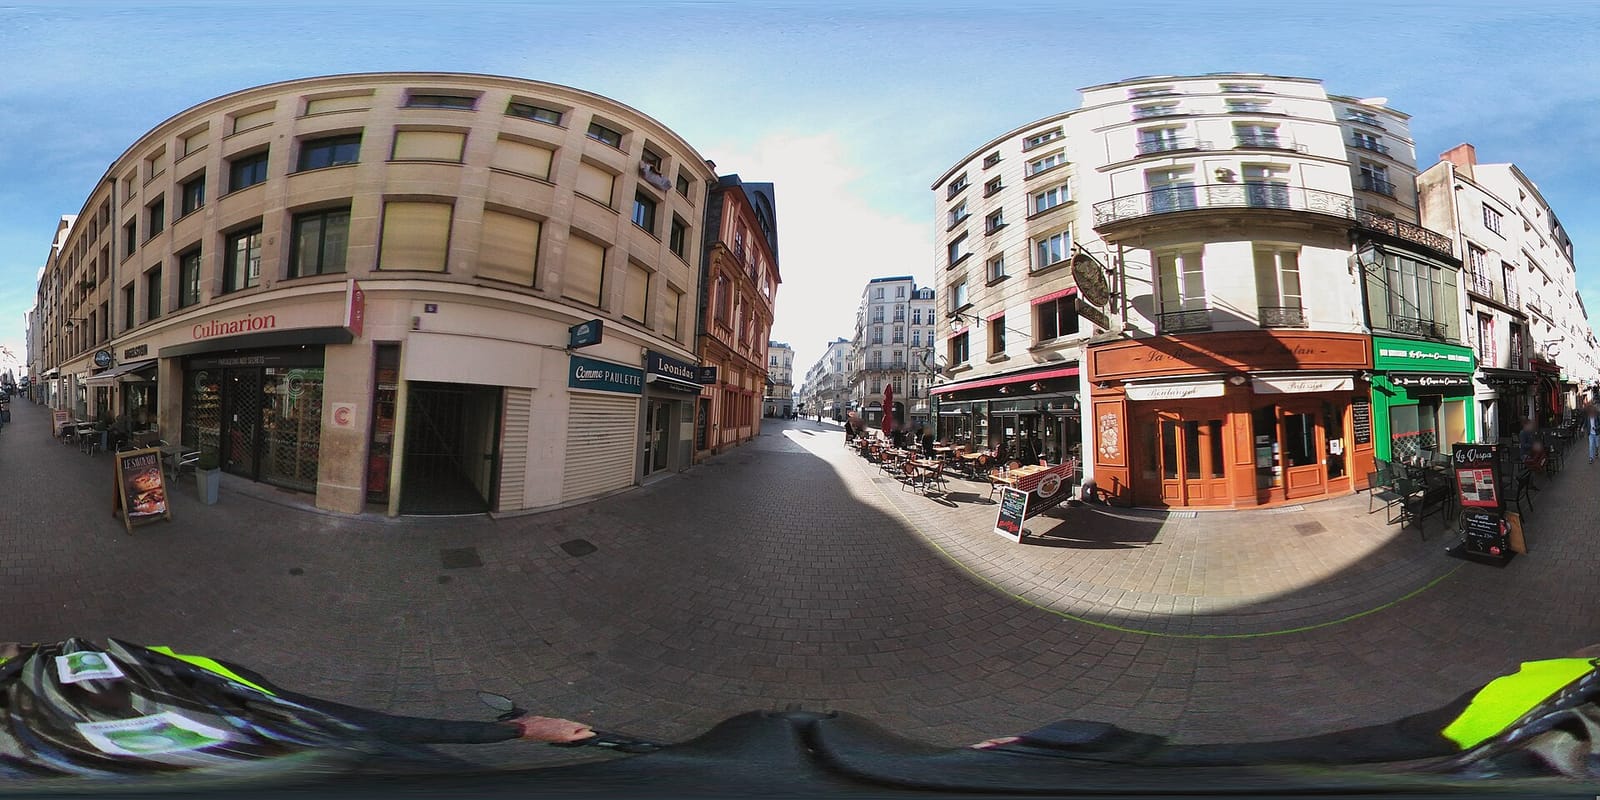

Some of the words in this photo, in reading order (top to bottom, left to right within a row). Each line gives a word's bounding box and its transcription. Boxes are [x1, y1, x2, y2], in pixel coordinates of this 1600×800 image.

[192, 314, 276, 340] Culinarion
[575, 365, 604, 382] Comme
[604, 371, 641, 387] PAULETTE
[658, 358, 694, 379] Leonidas
[1455, 449, 1466, 463] La
[1466, 448, 1493, 463] Vespa
